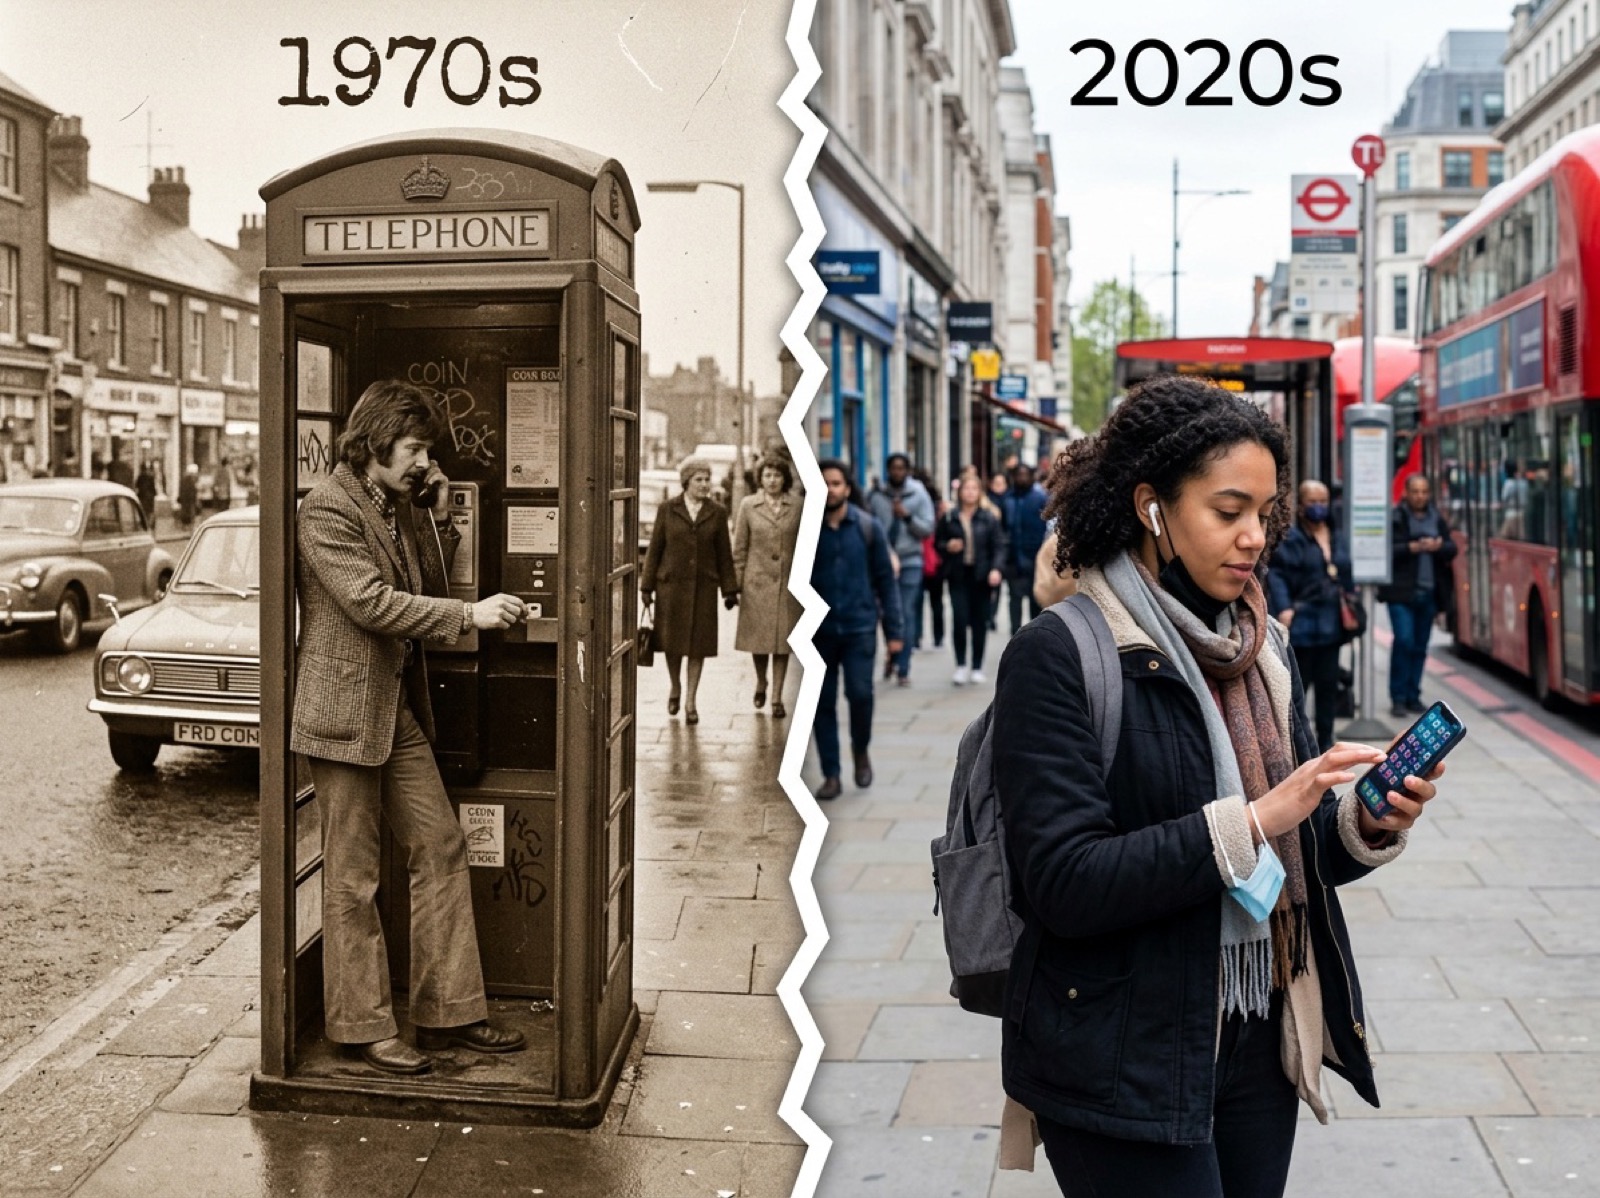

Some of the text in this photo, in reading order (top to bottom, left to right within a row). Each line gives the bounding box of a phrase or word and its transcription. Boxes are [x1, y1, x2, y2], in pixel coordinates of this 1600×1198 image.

[314, 214, 540, 251] TELEPHONE
[407, 357, 469, 385] COIN
[178, 724, 216, 742] FRD
